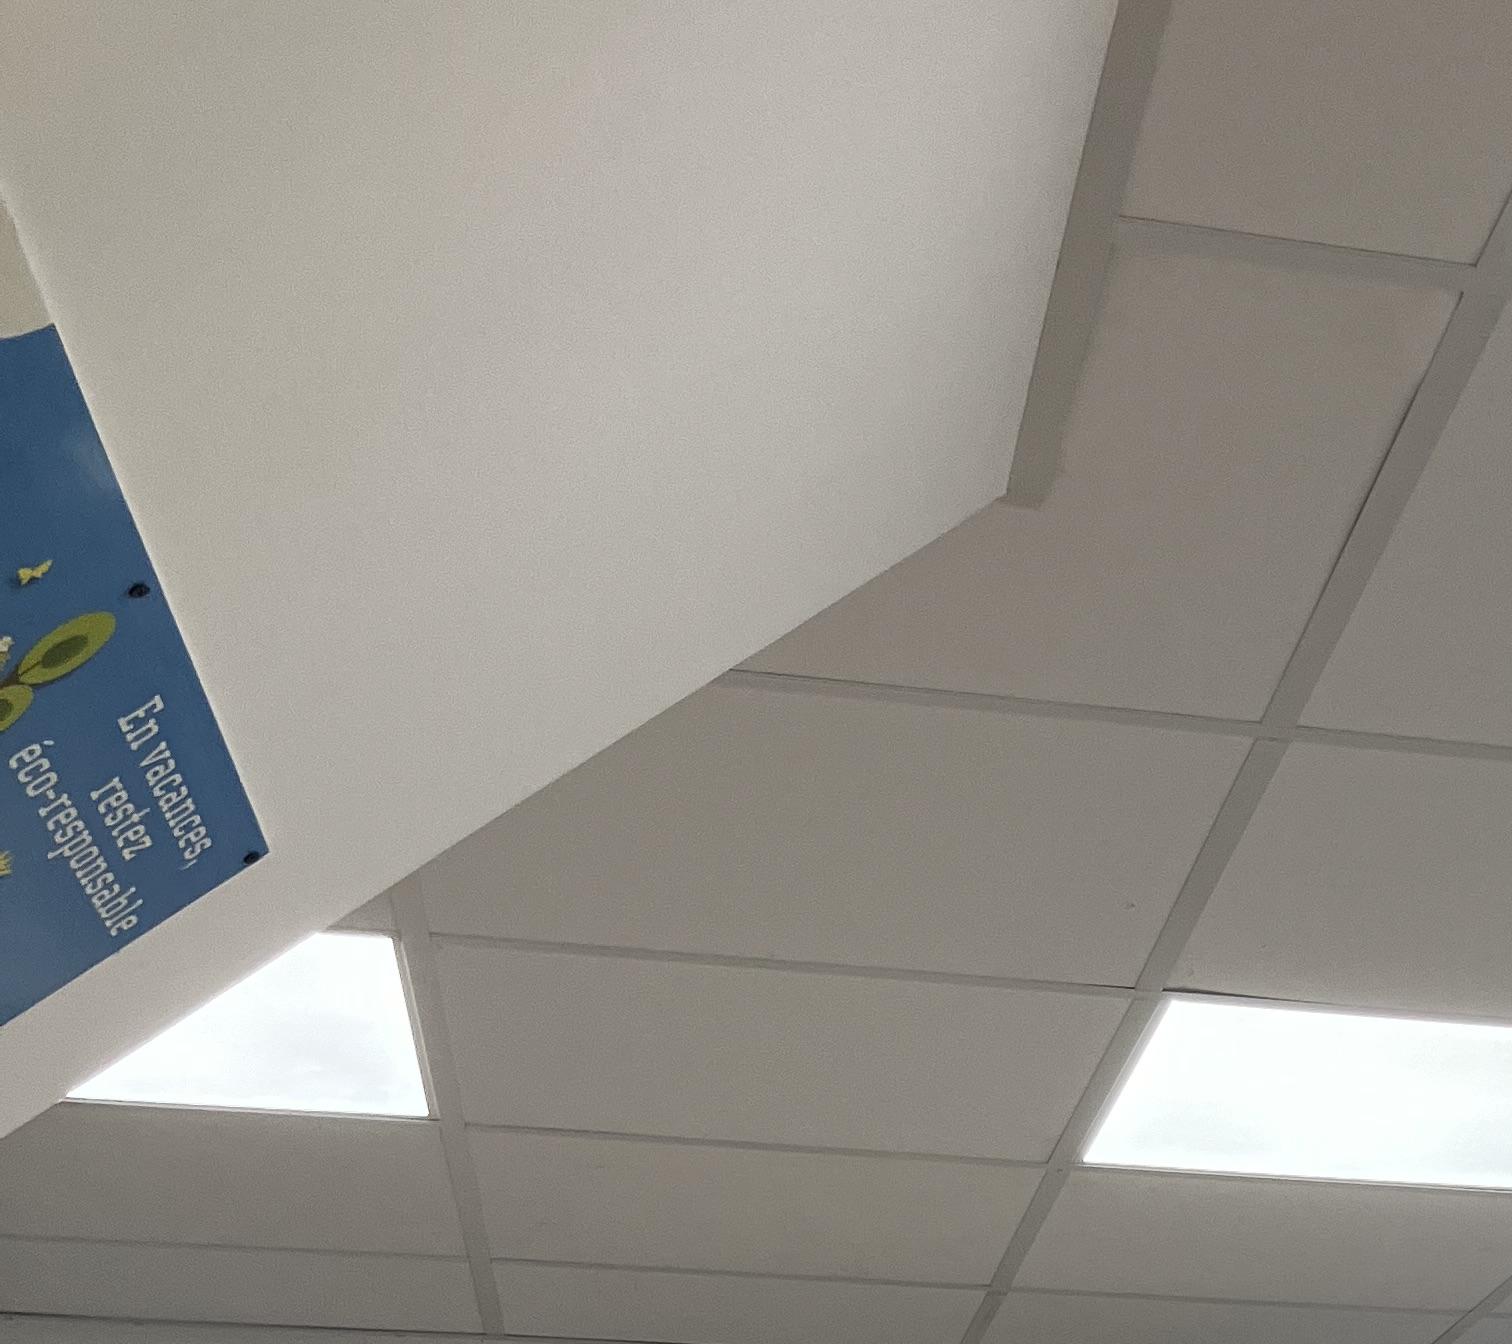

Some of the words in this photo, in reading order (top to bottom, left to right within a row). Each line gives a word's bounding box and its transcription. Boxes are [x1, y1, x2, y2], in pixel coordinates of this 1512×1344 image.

[117, 694, 164, 751] En
[9, 739, 143, 937] éco-responsable
[90, 776, 152, 861] restez
[138, 741, 212, 870] vacances,
